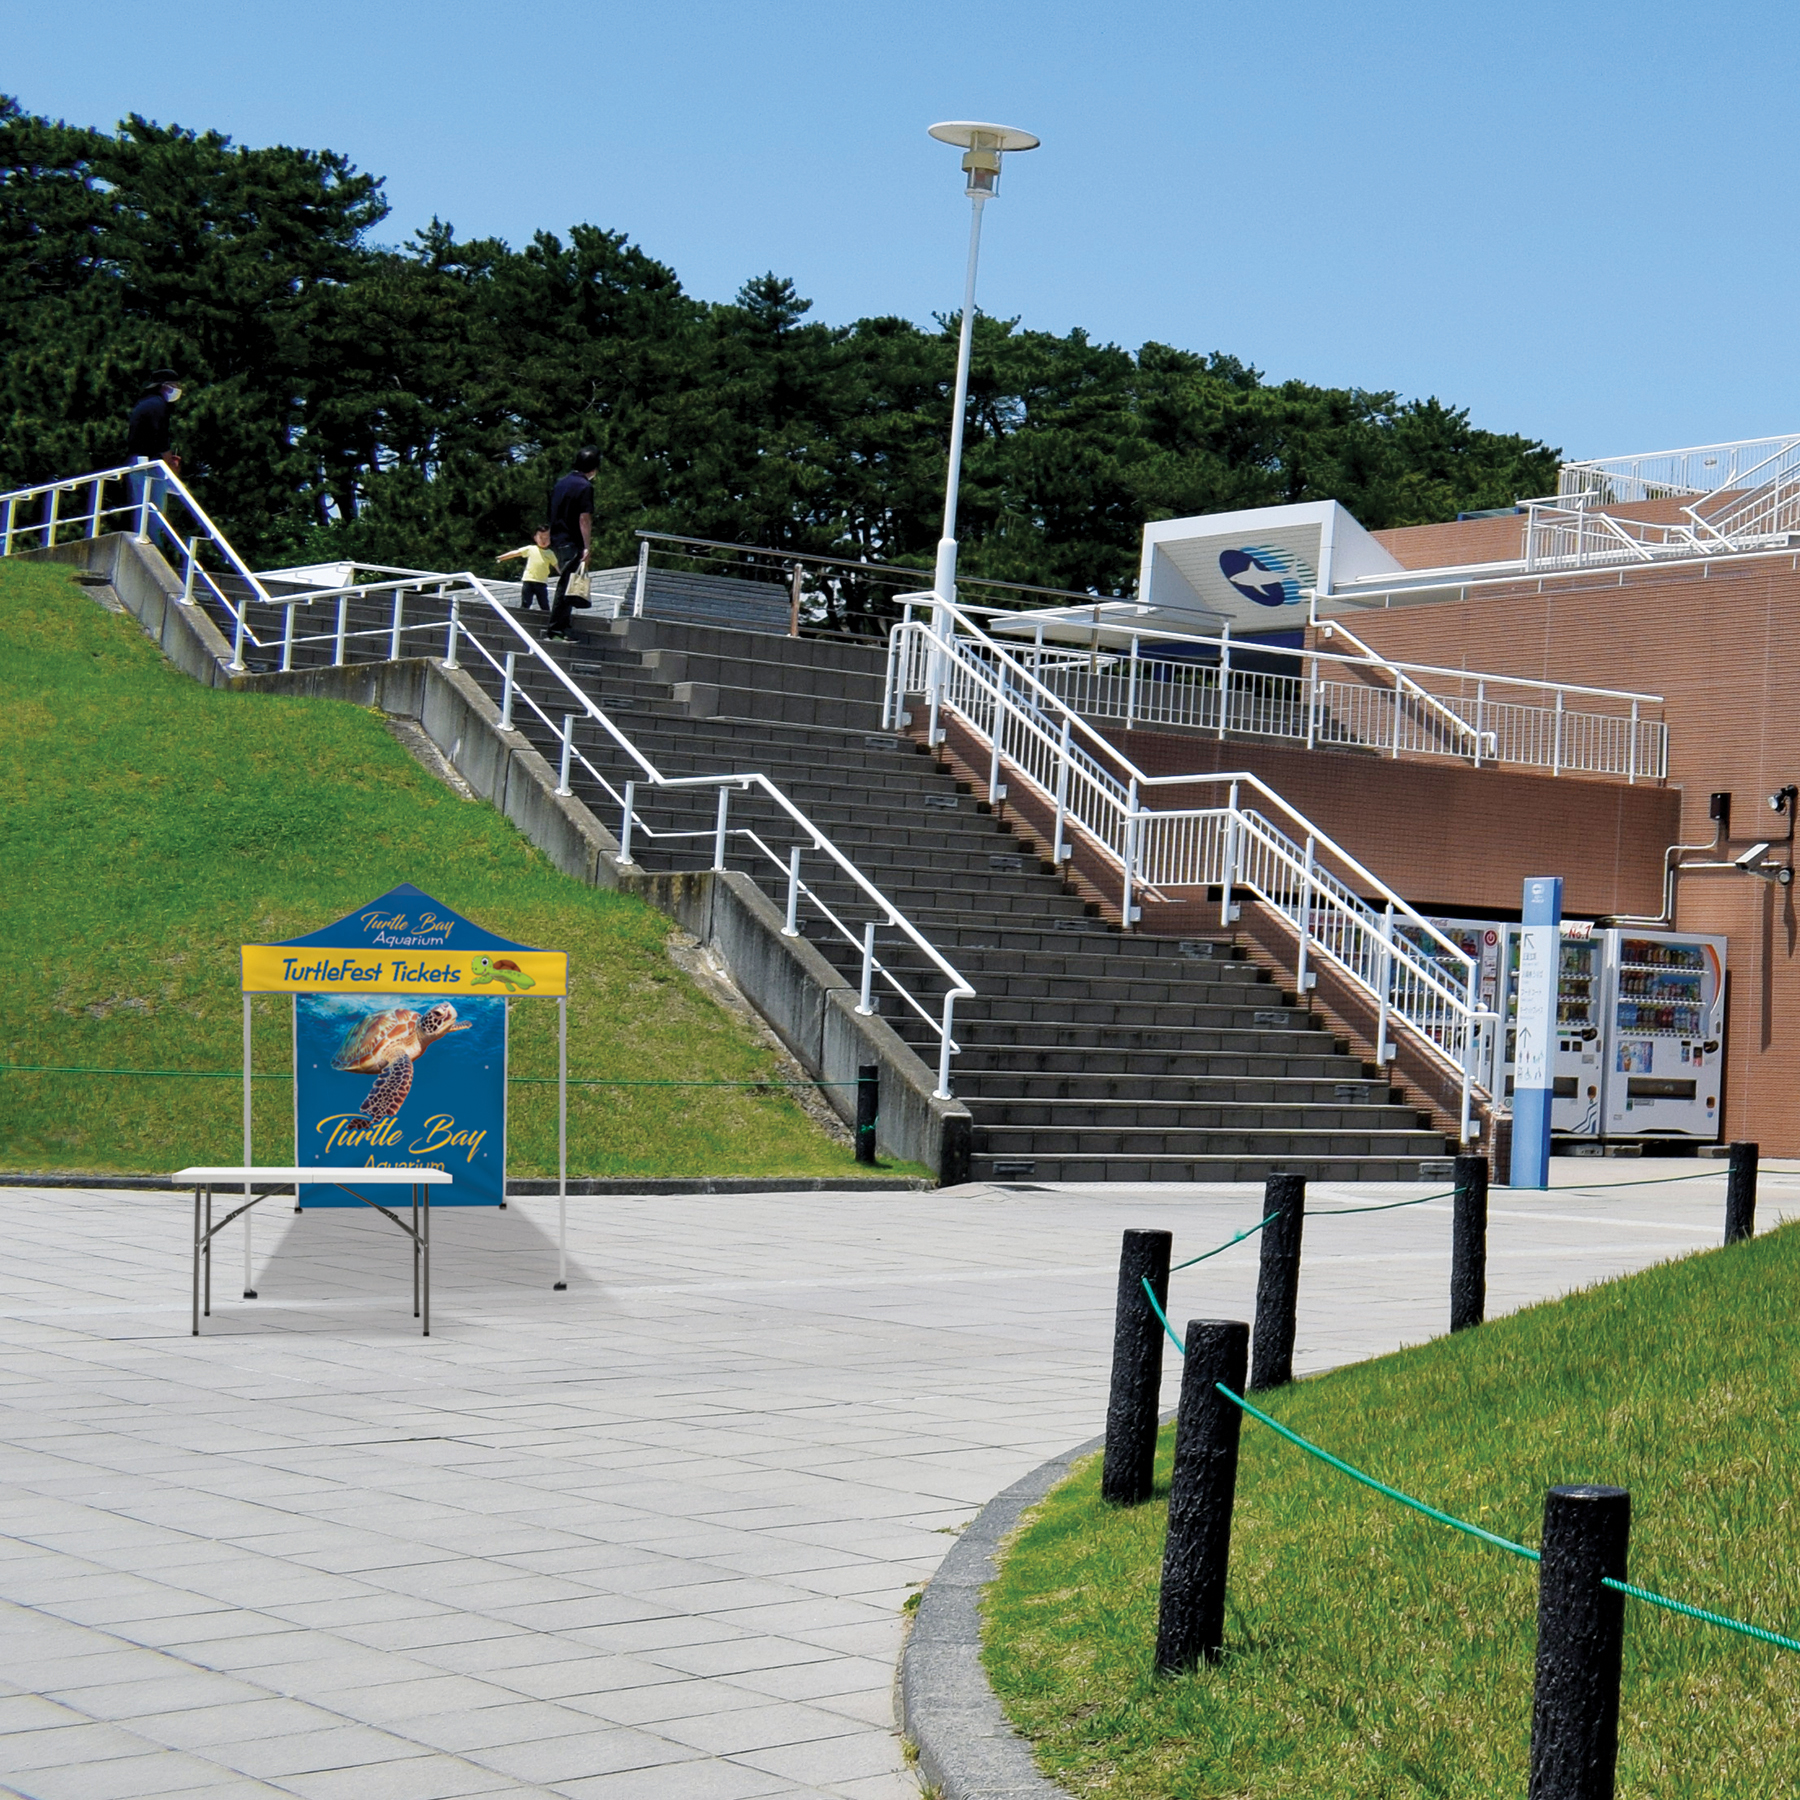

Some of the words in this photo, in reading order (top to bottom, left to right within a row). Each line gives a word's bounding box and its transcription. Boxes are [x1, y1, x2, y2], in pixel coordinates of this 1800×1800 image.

[361, 911, 409, 932] Turtle
[410, 912, 455, 939] Bay
[372, 930, 444, 948] Aquarium
[282, 957, 383, 982] TurtleFest
[391, 960, 462, 983] Tickets
[316, 1113, 404, 1154] Turtle
[408, 1113, 488, 1163] Bay
